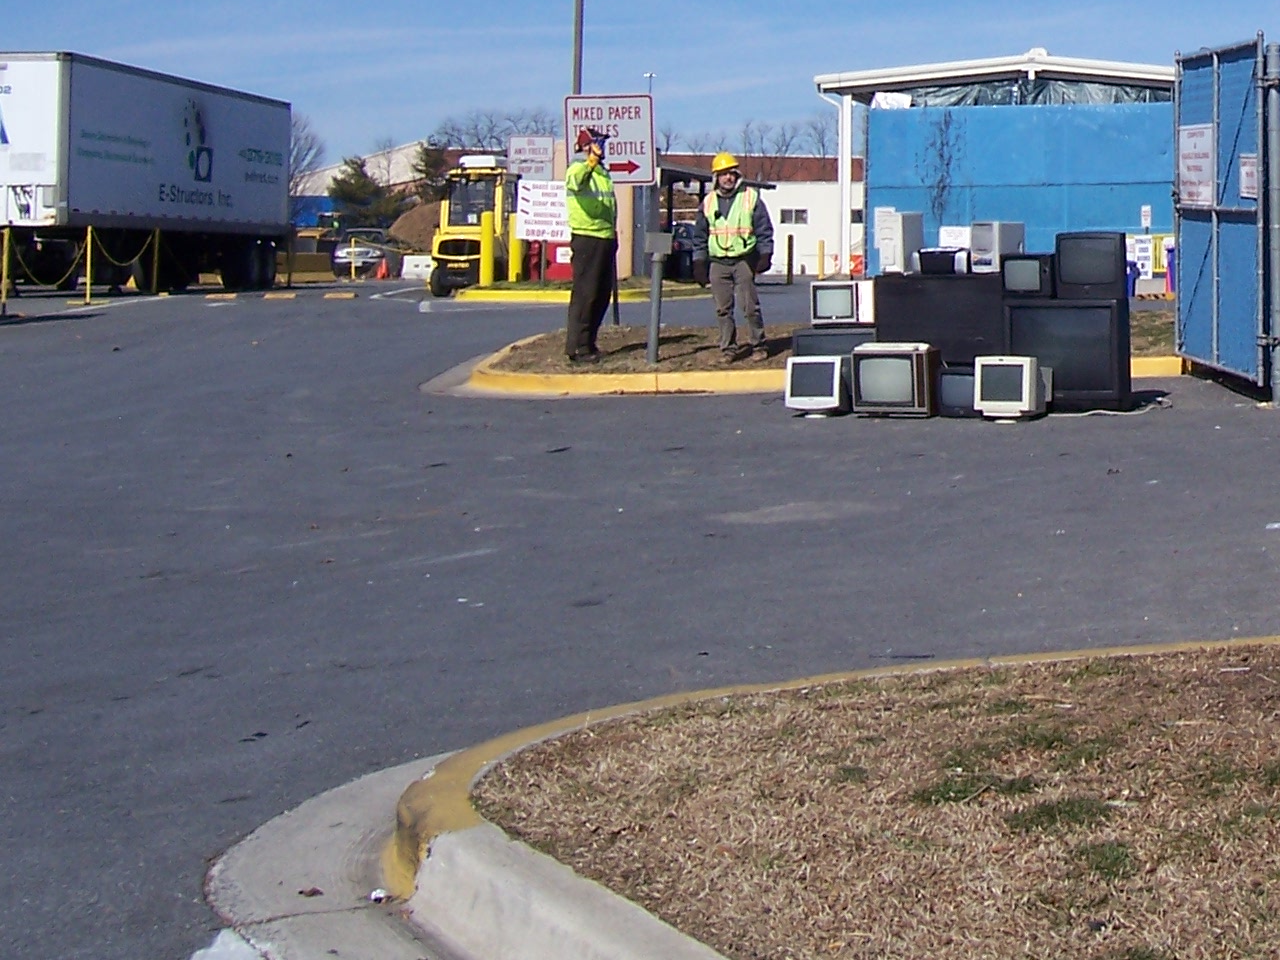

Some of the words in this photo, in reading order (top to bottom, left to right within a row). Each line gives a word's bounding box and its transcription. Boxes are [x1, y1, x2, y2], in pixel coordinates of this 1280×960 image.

[572, 107, 603, 121] MIXED
[608, 106, 641, 120] PAPER
[608, 141, 646, 156] BOTTLE
[525, 228, 565, 238] DROP-OFF
